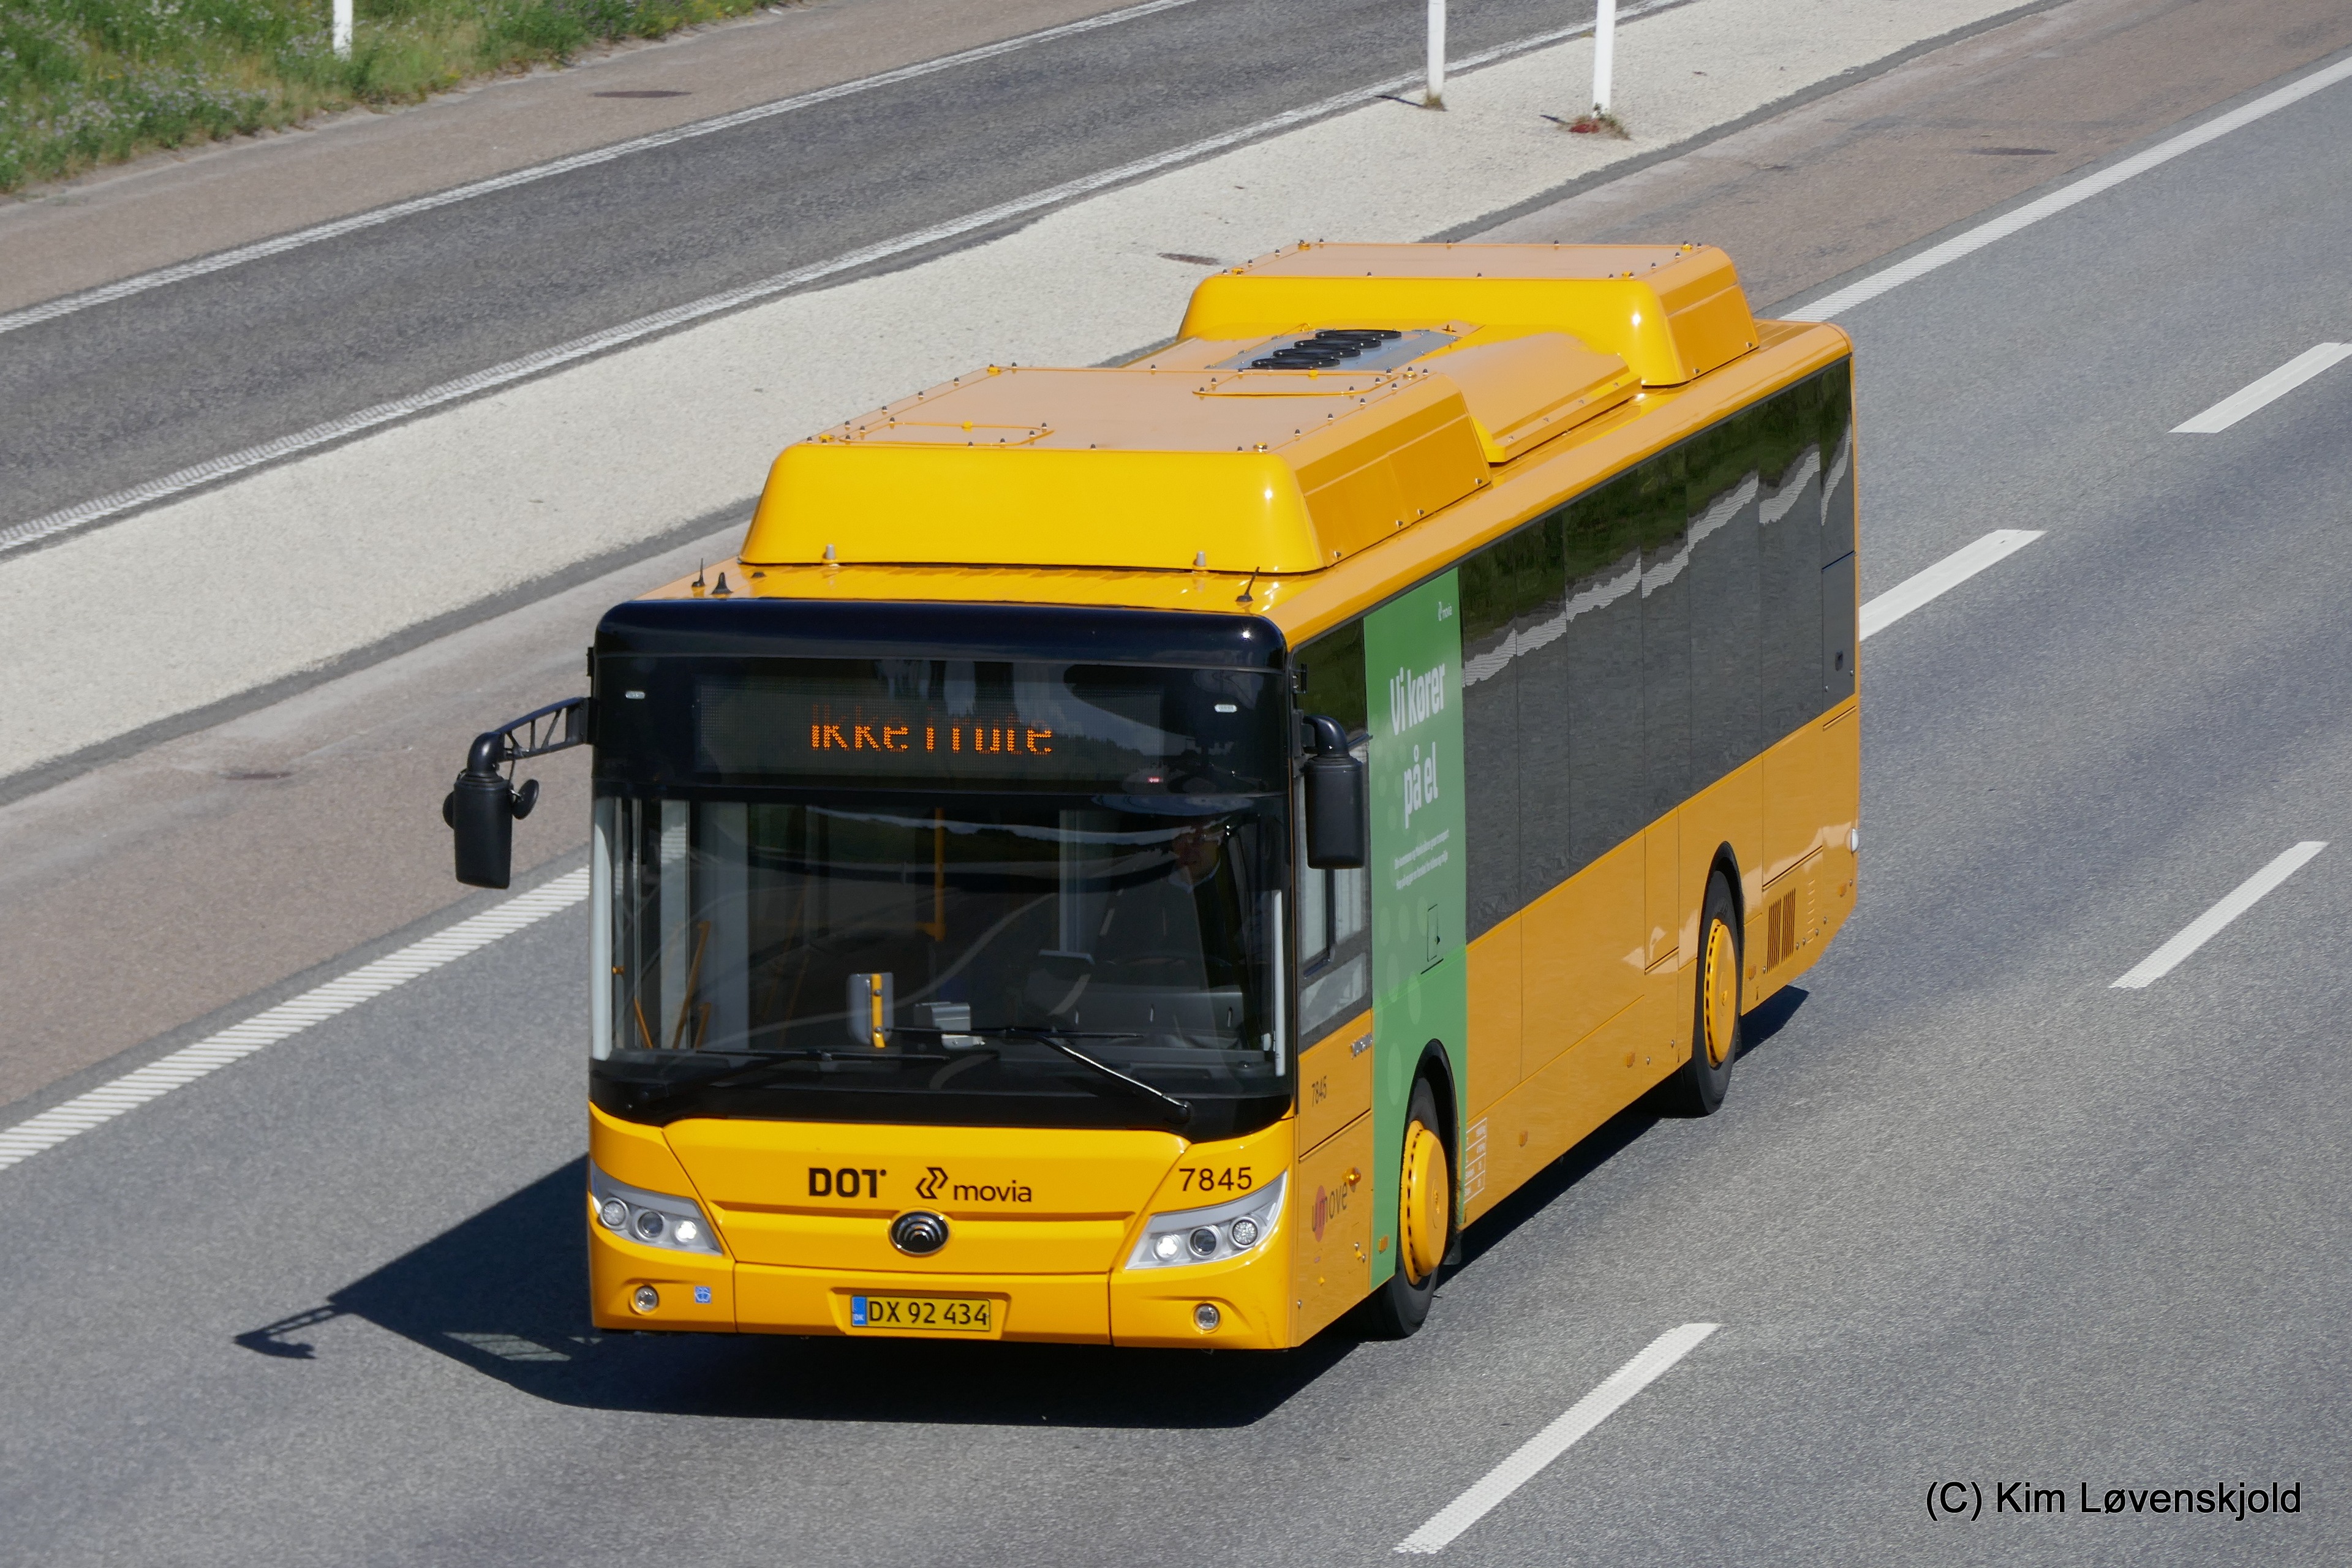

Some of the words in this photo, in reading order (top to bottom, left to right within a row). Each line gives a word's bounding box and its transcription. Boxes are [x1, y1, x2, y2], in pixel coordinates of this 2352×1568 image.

[1390, 667, 1406, 736] Vi
[1407, 663, 1445, 728] kører
[812, 705, 909, 751] Ikke
[1404, 744, 1422, 829] på
[1423, 742, 1439, 804] el
[1311, 1075, 1327, 1107] 7845
[809, 1167, 878, 1198] DOT
[953, 1180, 1033, 1202] movia
[1179, 1167, 1252, 1191] 7845
[869, 1301, 901, 1323] DX
[908, 1302, 936, 1324] 92
[944, 1303, 987, 1325] 434
